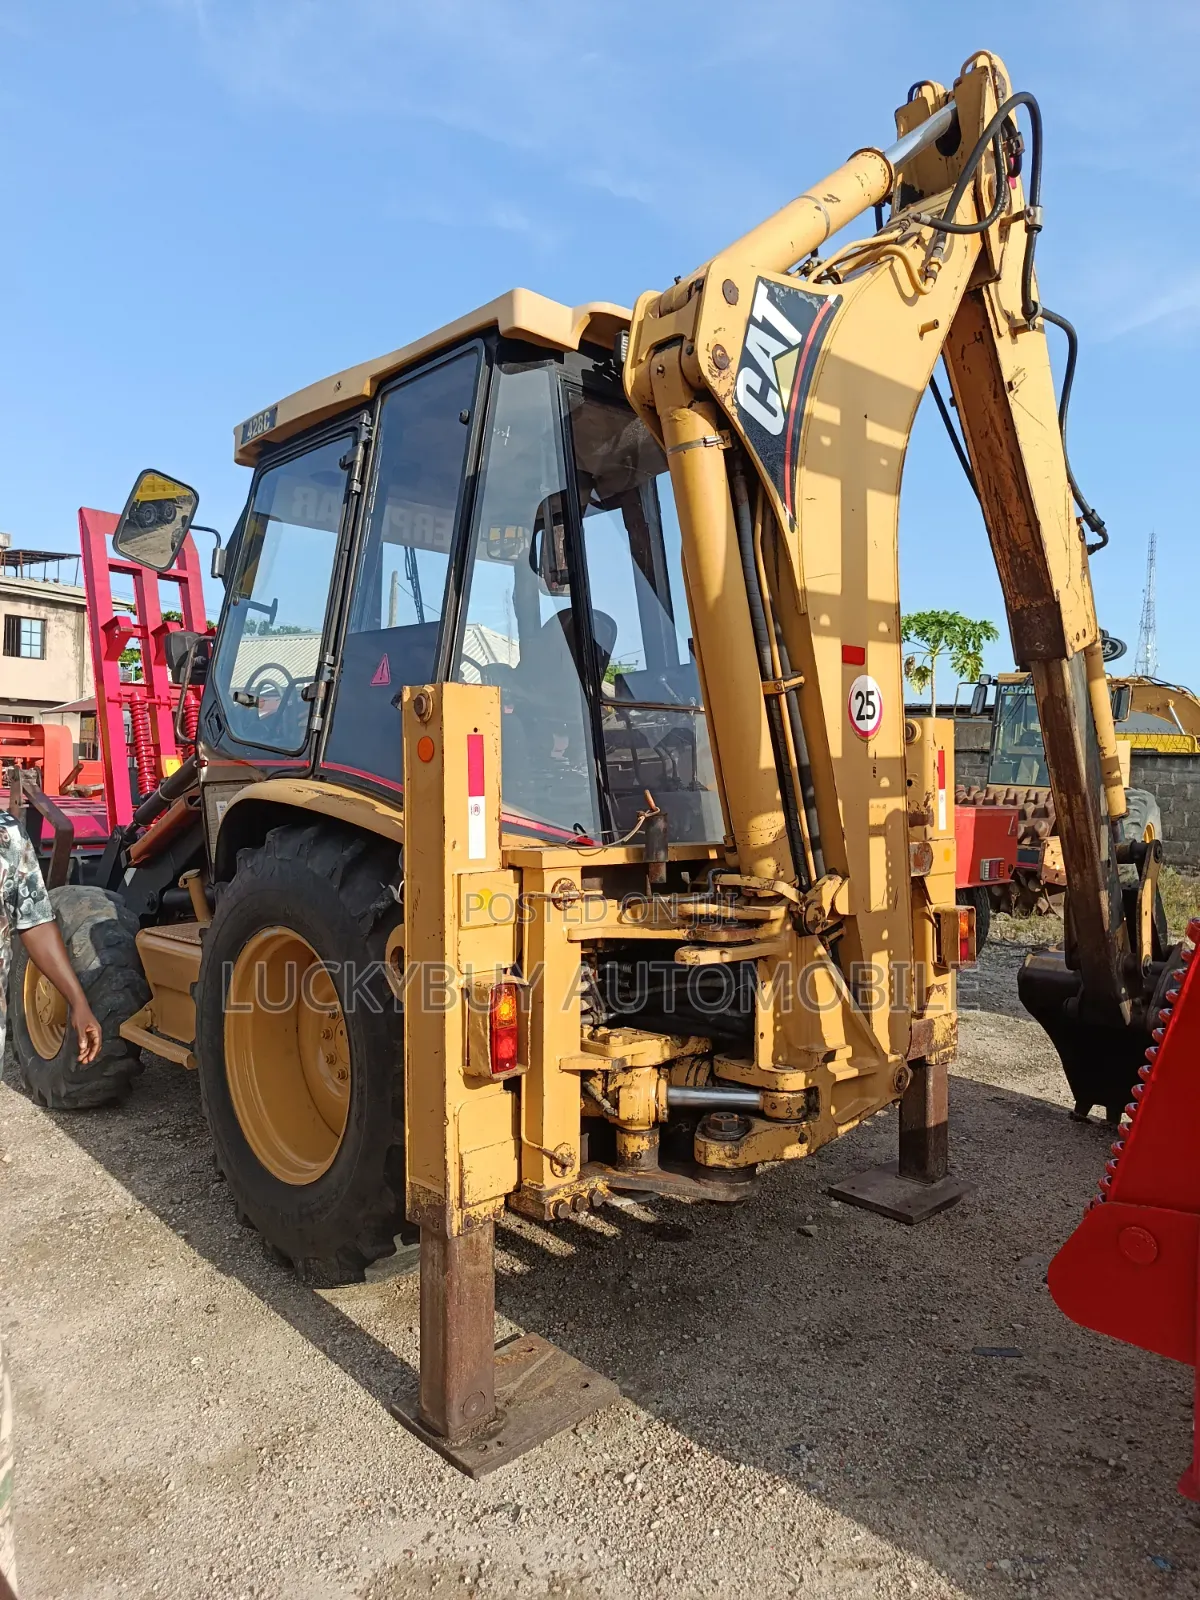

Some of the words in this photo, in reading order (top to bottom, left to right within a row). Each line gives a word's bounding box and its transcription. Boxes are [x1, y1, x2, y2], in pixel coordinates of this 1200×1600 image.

[735, 279, 803, 436] CAT
[247, 411, 270, 440] 428C
[855, 690, 876, 721] 25
